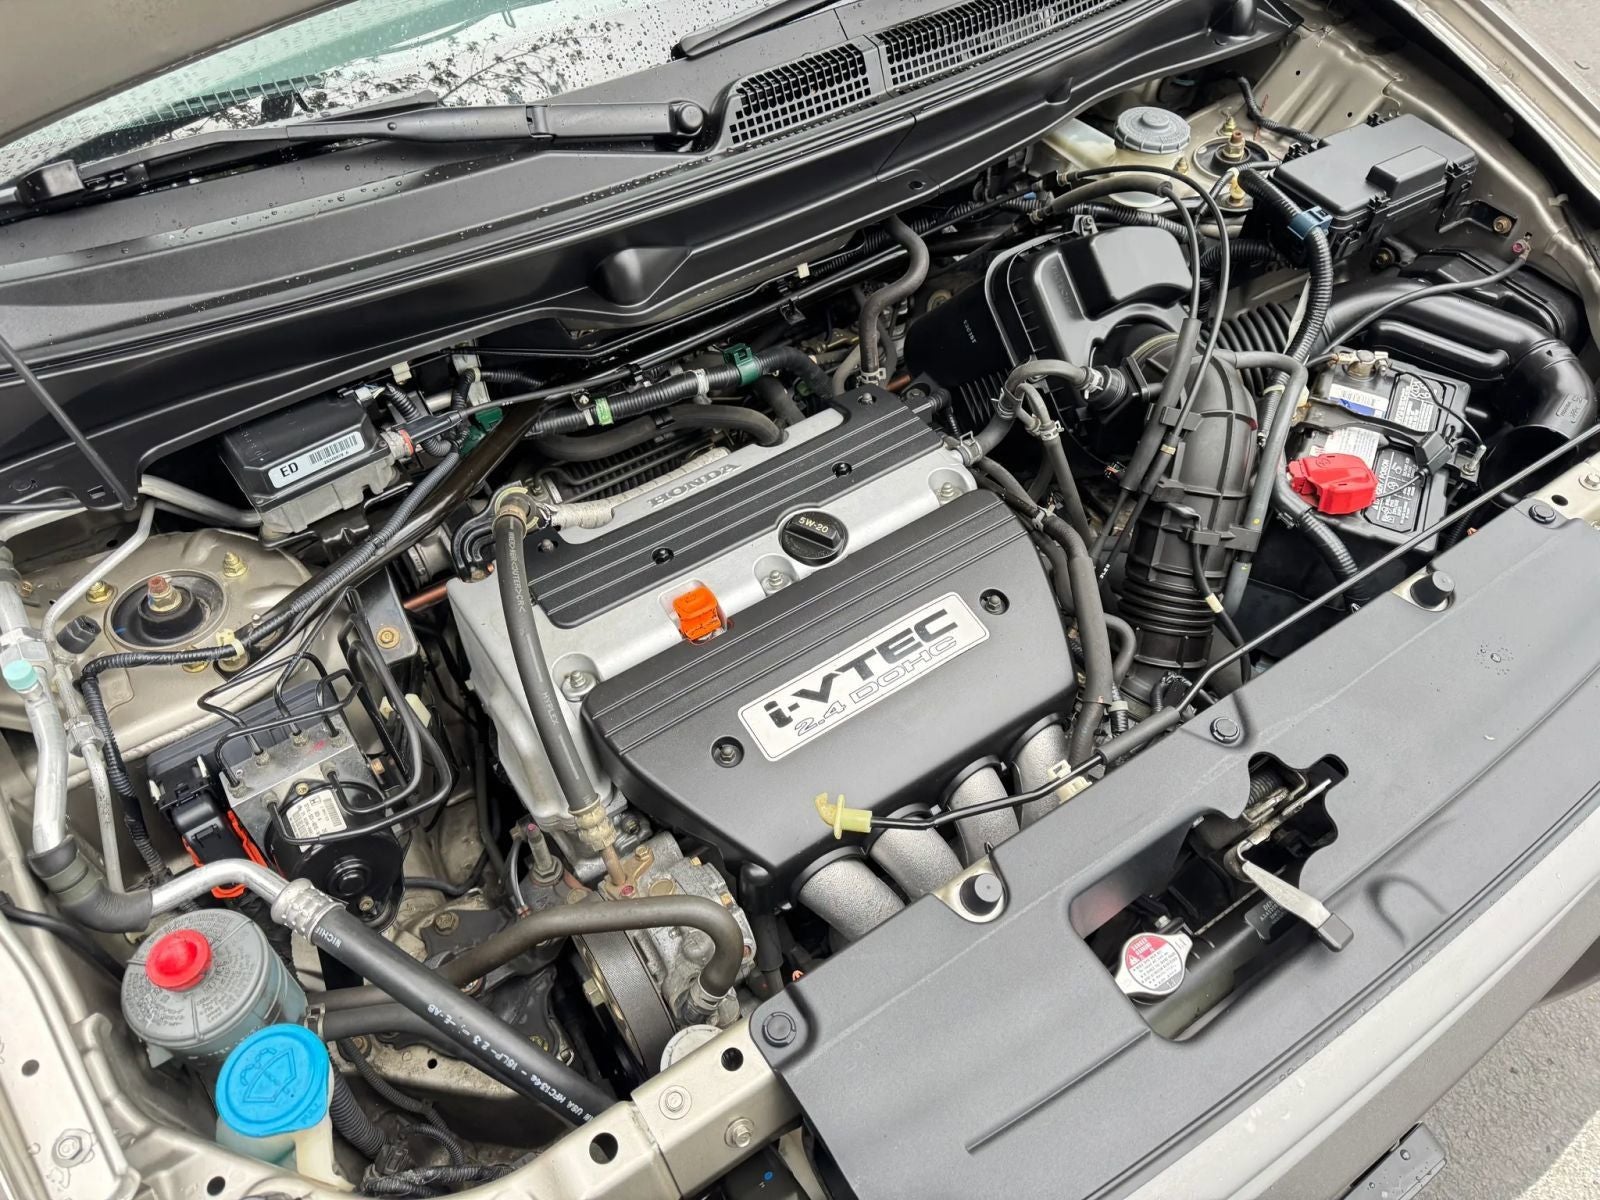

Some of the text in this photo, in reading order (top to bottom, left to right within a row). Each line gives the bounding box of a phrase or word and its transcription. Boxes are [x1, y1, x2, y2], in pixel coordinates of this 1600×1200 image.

[279, 462, 299, 478] ED
[648, 463, 743, 508] HONDA
[798, 516, 829, 533] 5W-20
[763, 608, 958, 728] i-VTEC
[794, 636, 957, 736] 2.4 DOHC
[565, 1100, 584, 1116] USA
